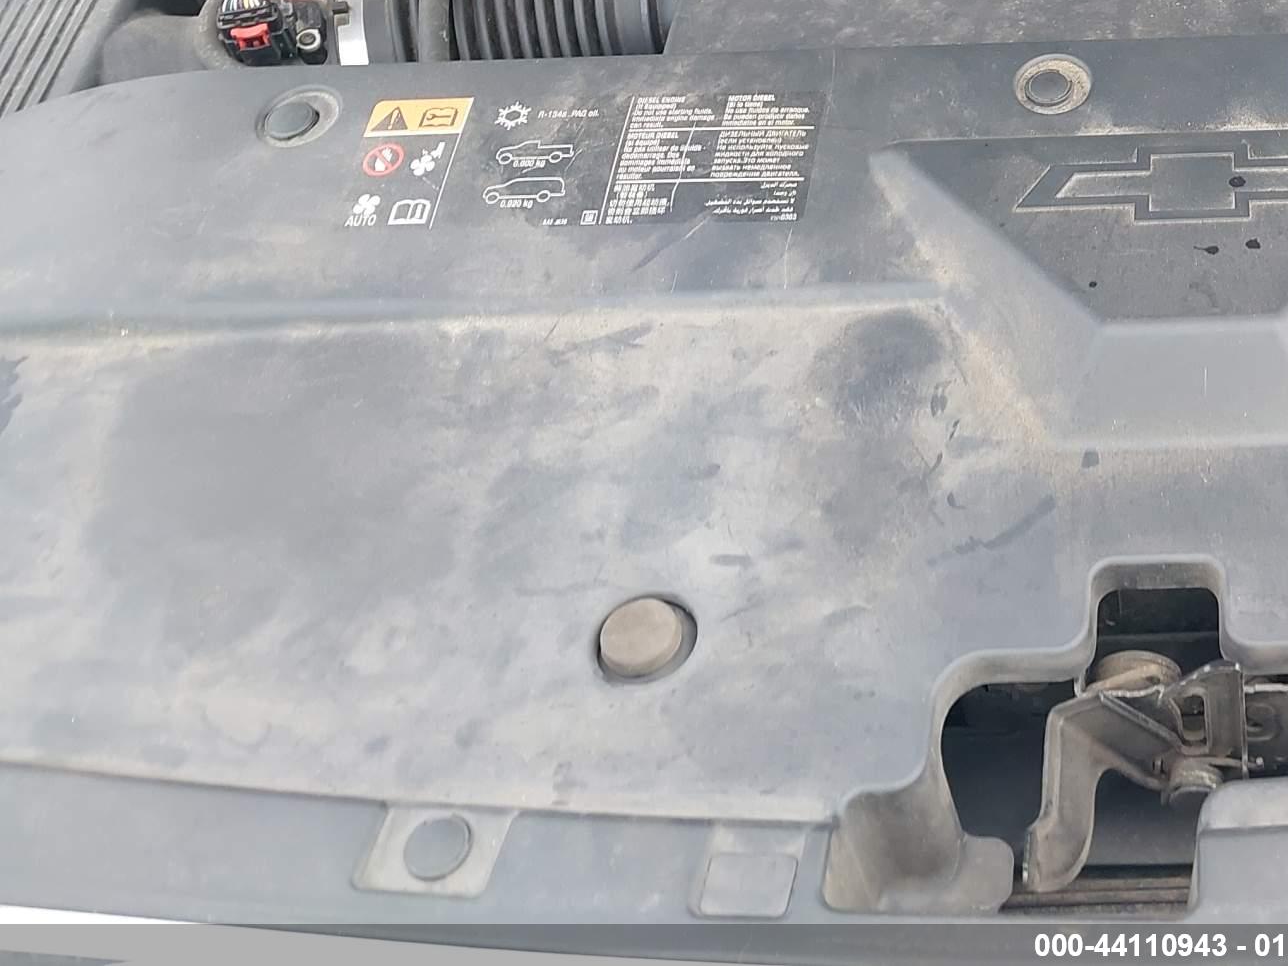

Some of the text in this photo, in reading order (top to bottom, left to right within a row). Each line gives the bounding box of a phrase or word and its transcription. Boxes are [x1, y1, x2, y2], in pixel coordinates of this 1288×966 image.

[728, 94, 775, 102] MOTOR DIESEL
[656, 131, 679, 139] DIESEL
[523, 199, 534, 208] kg
[344, 214, 377, 226] AUTO
